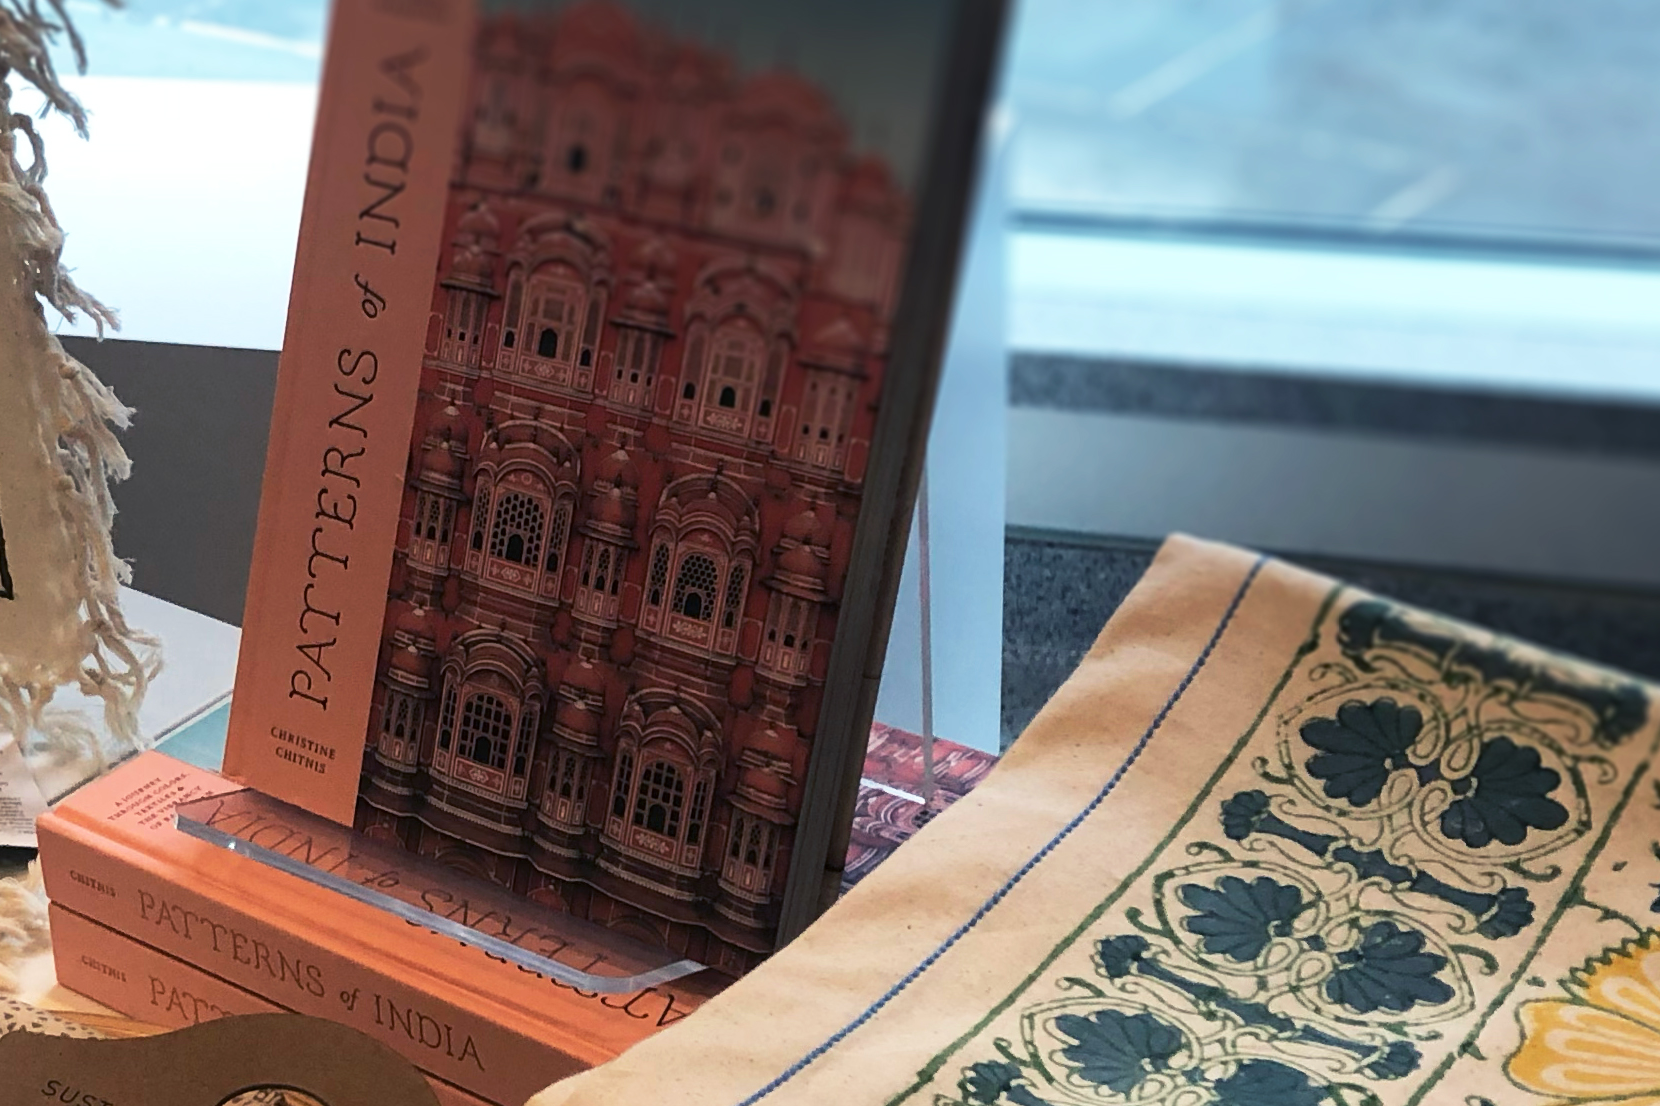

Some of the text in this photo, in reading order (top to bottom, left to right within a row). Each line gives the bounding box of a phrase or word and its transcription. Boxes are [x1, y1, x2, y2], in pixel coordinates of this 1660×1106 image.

[354, 45, 431, 256] INDIA
[354, 273, 386, 318] of
[289, 348, 378, 711] PATTERNS
[270, 726, 336, 760] CHRISTINE
[275, 746, 327, 774] CHITNIS
[138, 888, 326, 998] PATTERNS
[340, 988, 360, 1011] of
[374, 994, 485, 1071] INDIA
